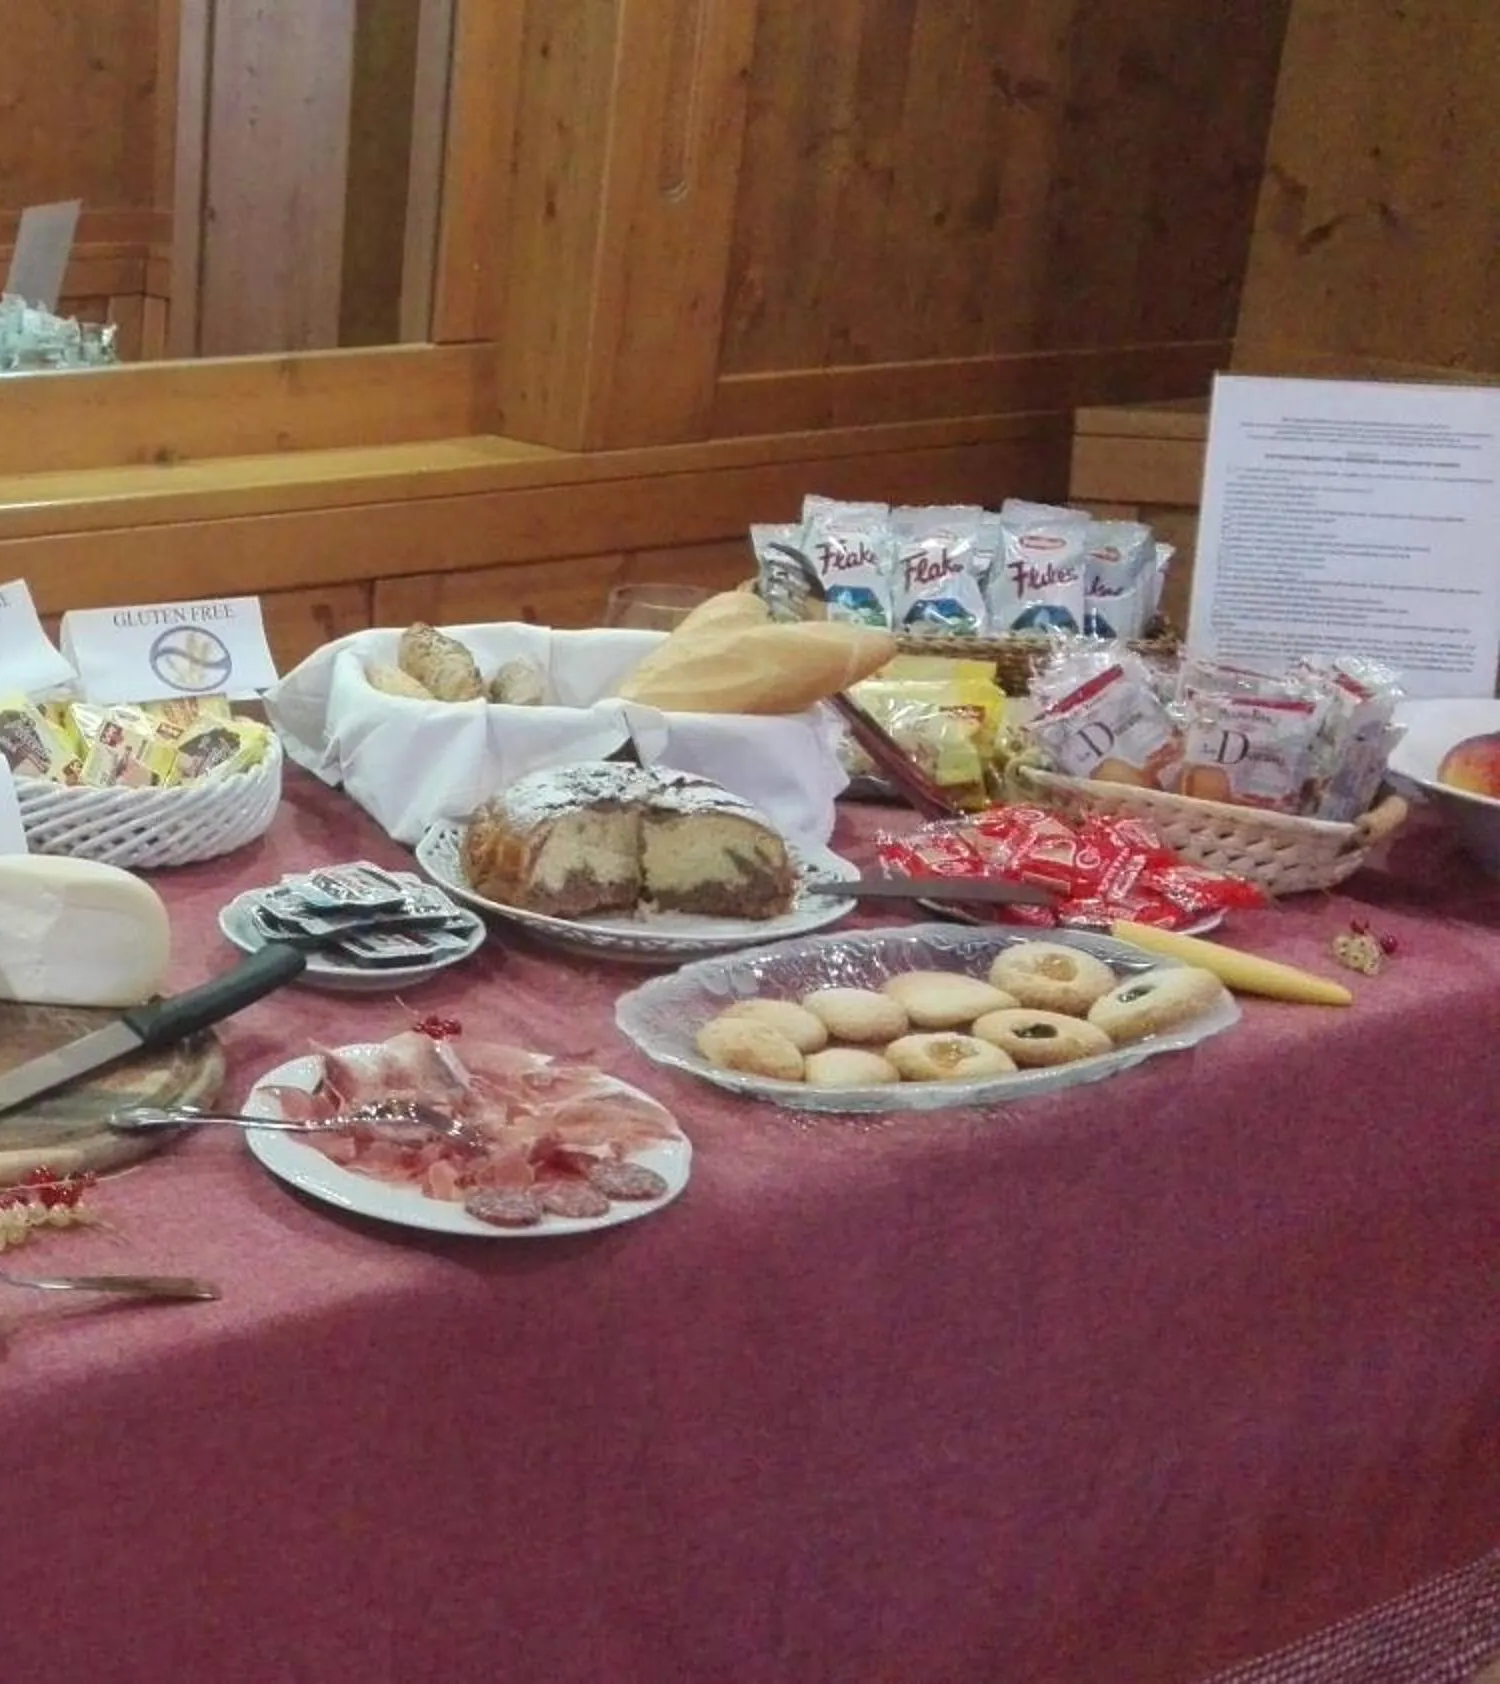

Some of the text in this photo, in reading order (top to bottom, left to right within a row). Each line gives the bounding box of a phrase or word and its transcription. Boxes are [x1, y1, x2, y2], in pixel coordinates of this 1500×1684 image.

[815, 541, 879, 576] Flak
[899, 547, 965, 593] Flak
[113, 603, 233, 627] GLUTEN FREE
